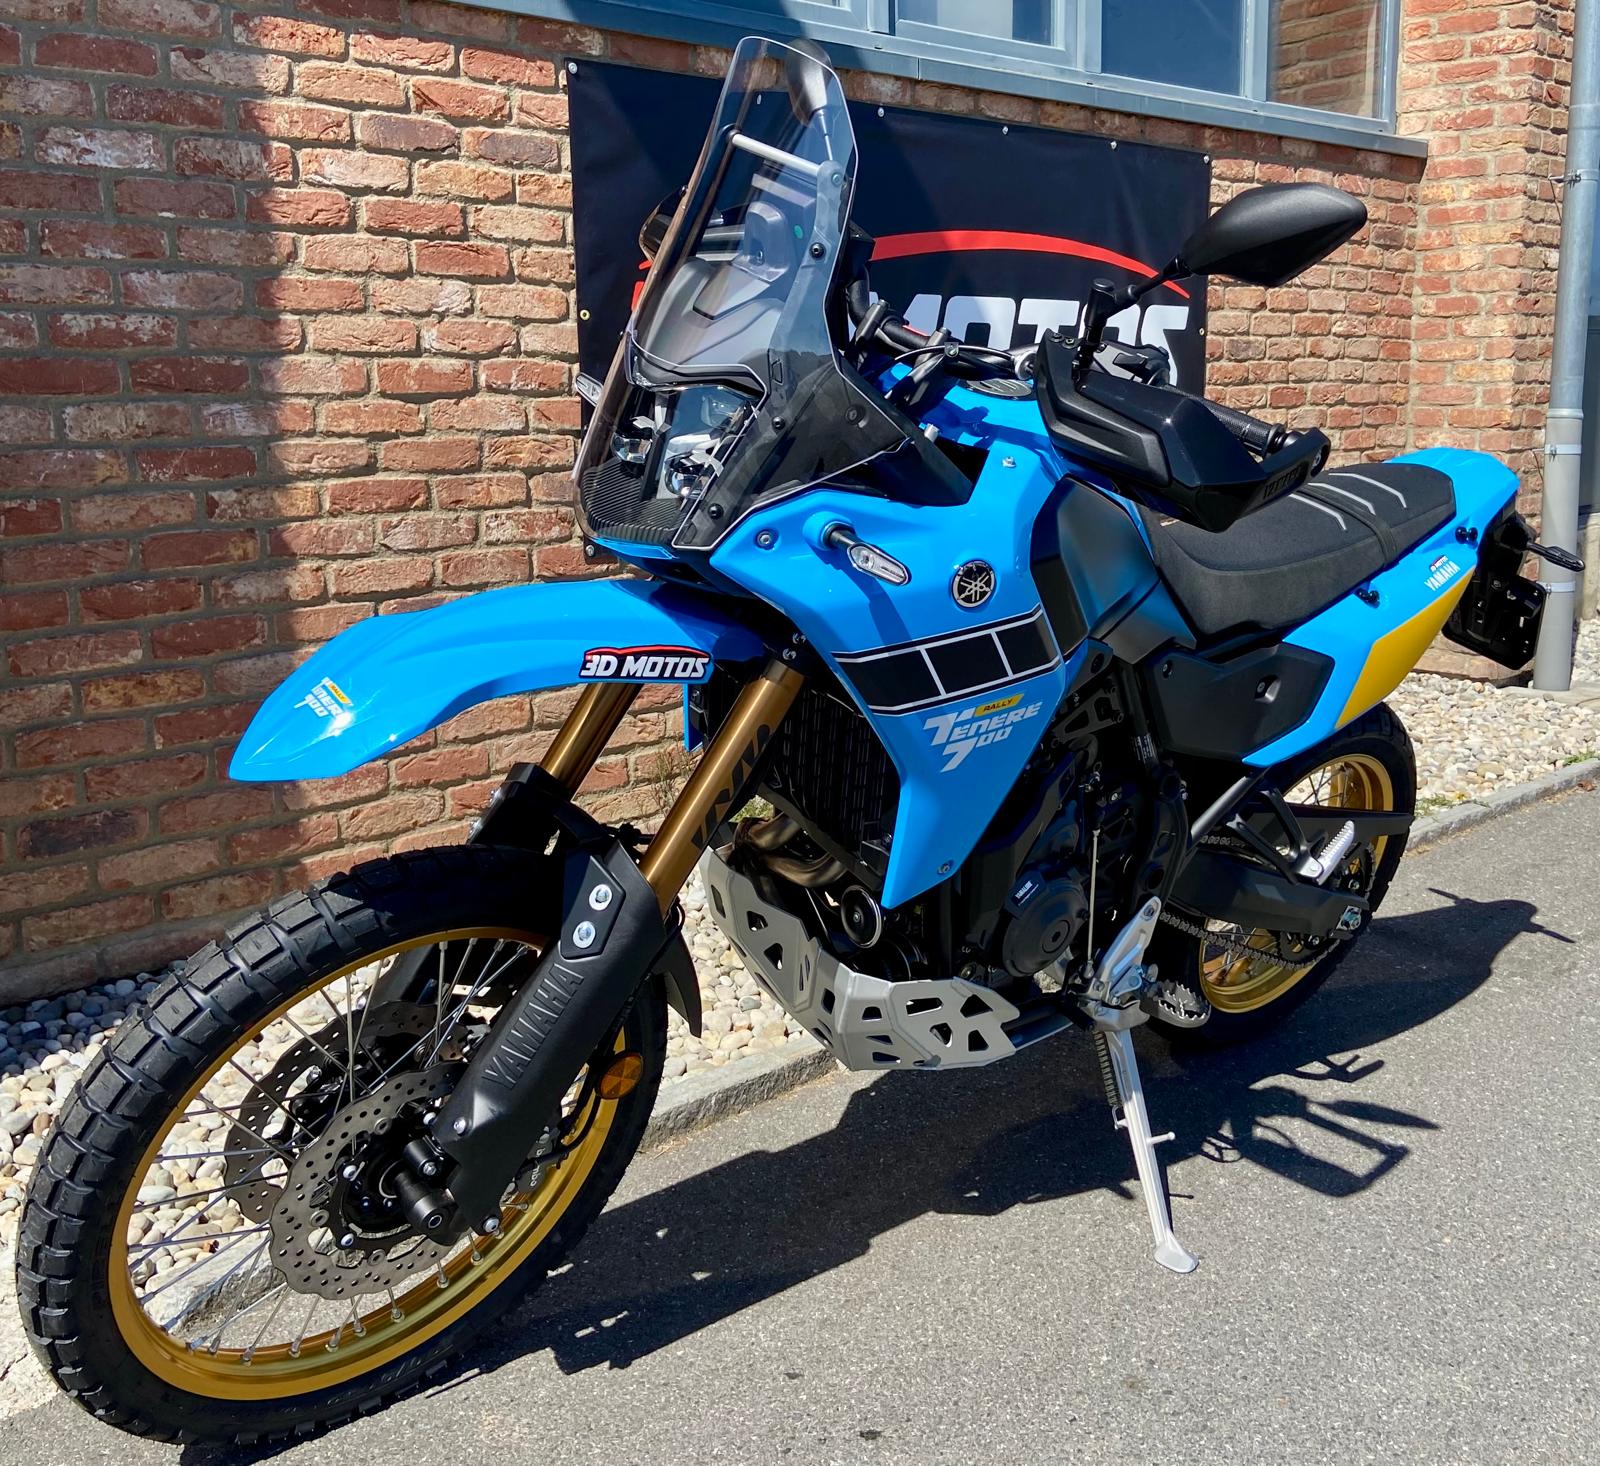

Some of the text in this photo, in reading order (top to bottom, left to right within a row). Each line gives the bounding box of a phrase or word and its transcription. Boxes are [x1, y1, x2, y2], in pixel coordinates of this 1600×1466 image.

[1423, 560, 1461, 592] YAMAHA
[580, 655, 710, 678] 3D MOTOS
[923, 701, 1043, 746] TENERE
[983, 698, 1013, 712] RALLY
[940, 725, 1013, 774] 700
[481, 963, 585, 1091] YAMAHA
[529, 1146, 546, 1187] bmbo
